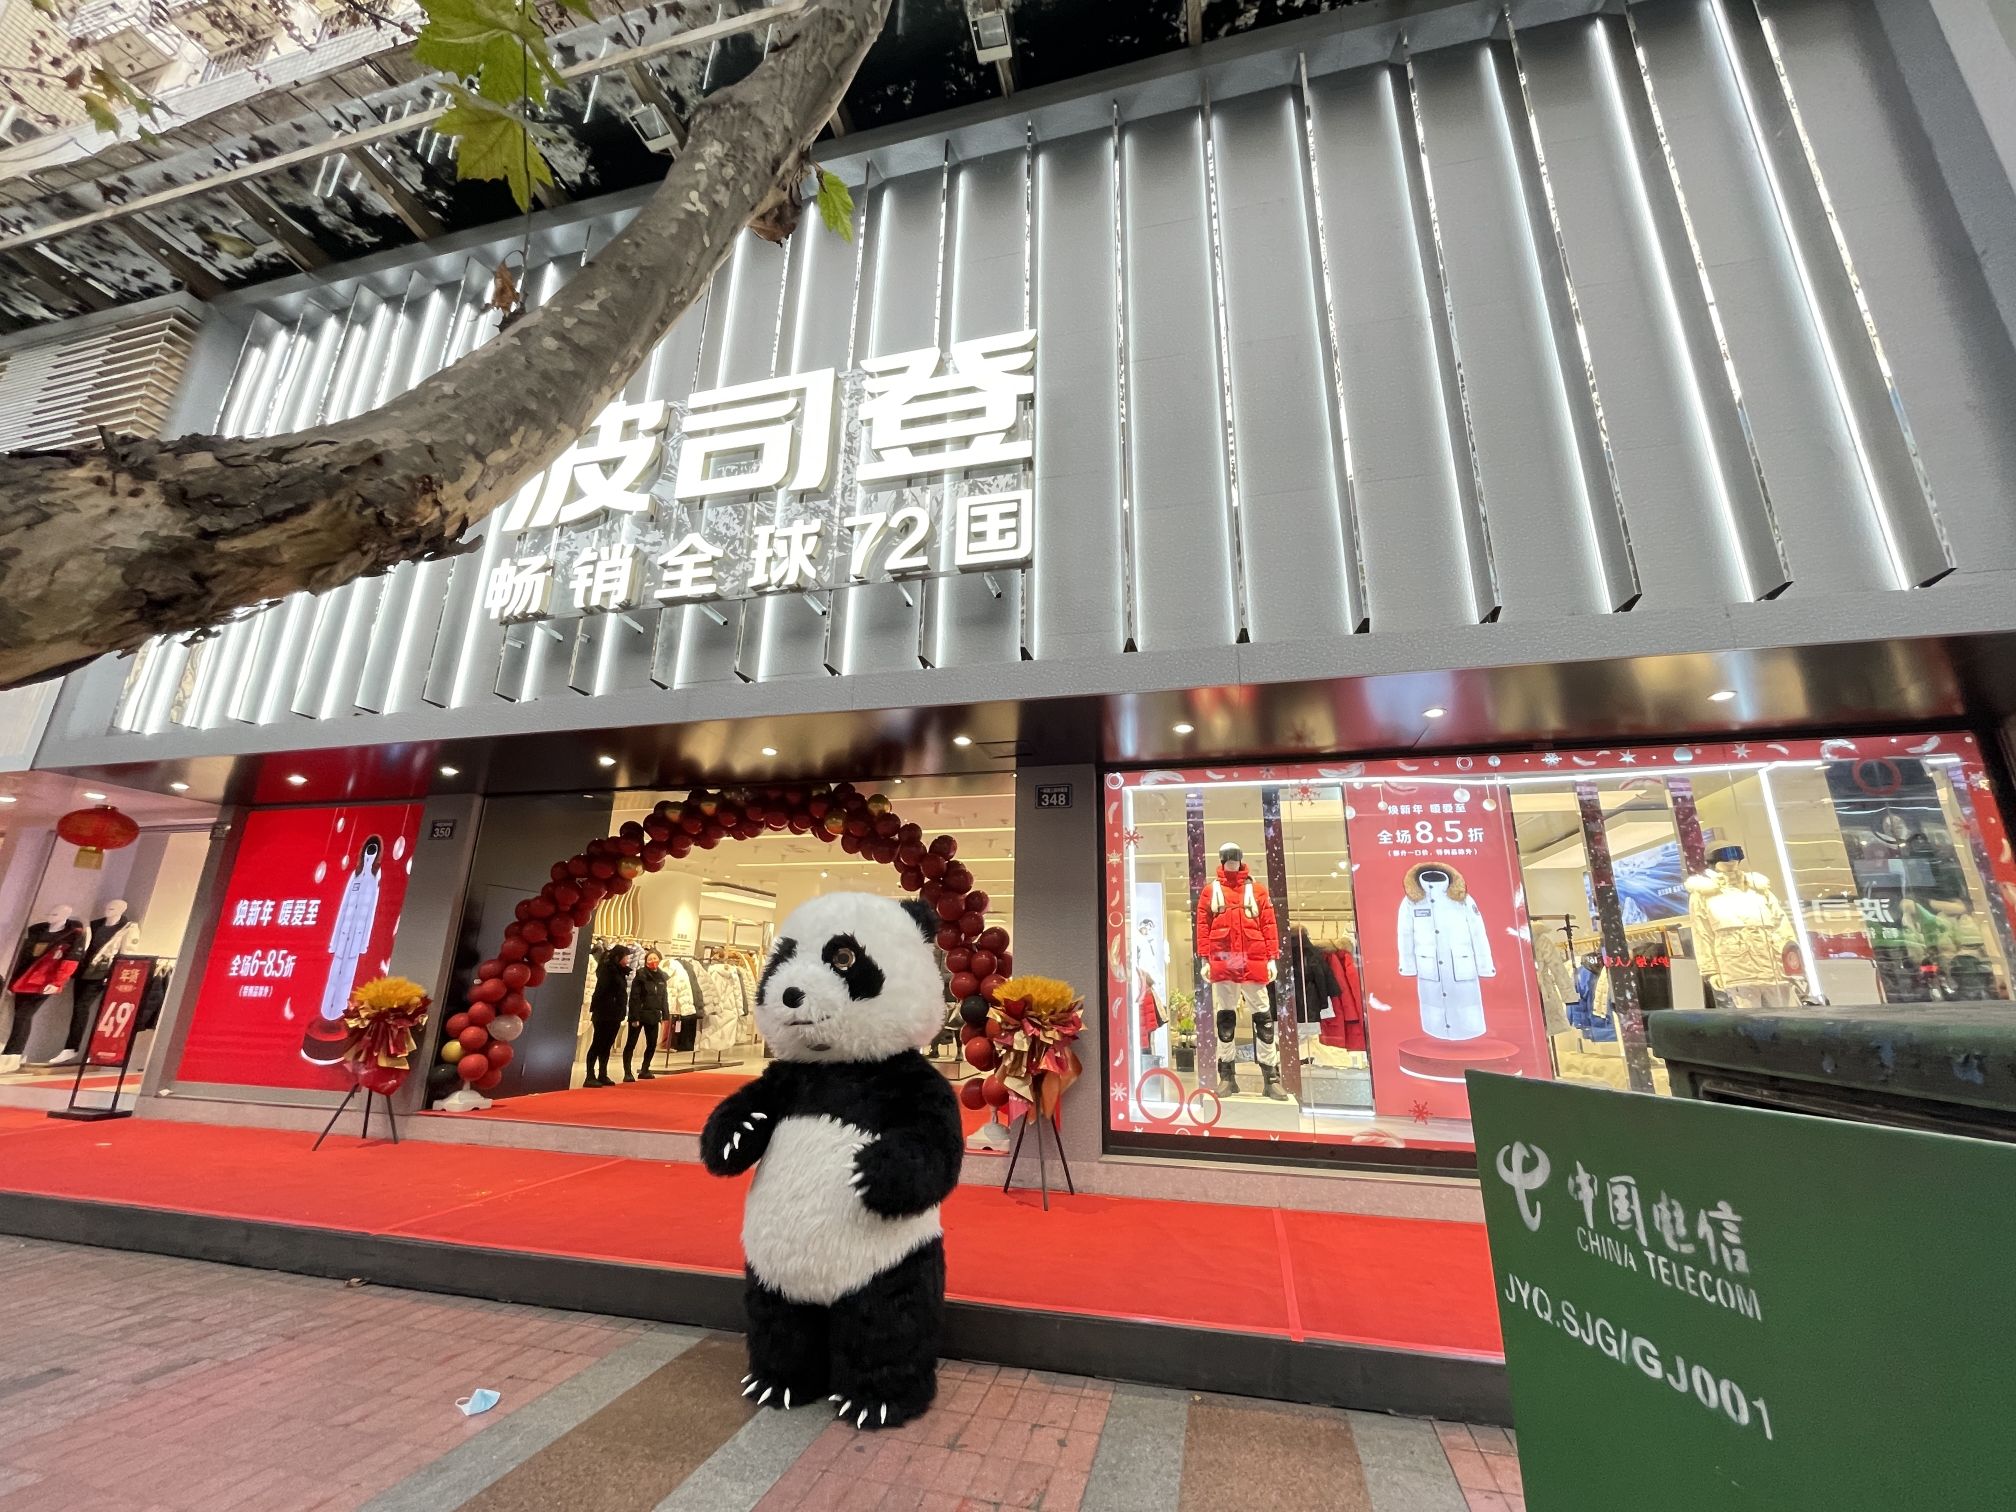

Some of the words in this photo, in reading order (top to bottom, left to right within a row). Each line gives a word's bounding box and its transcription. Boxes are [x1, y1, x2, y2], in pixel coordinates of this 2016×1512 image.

[484, 489, 1033, 620] 畅销全球72国
[1041, 793, 1066, 806] 348
[433, 827, 451, 838] 350
[1377, 820, 1485, 844] 全场8.5折
[278, 900, 321, 926] 暖爱至
[98, 1002, 135, 1037] 49
[1568, 1160, 1749, 1274] 中国电信
[1577, 1226, 1638, 1272] CHINA
[1644, 1250, 1762, 1322] TELECOM
